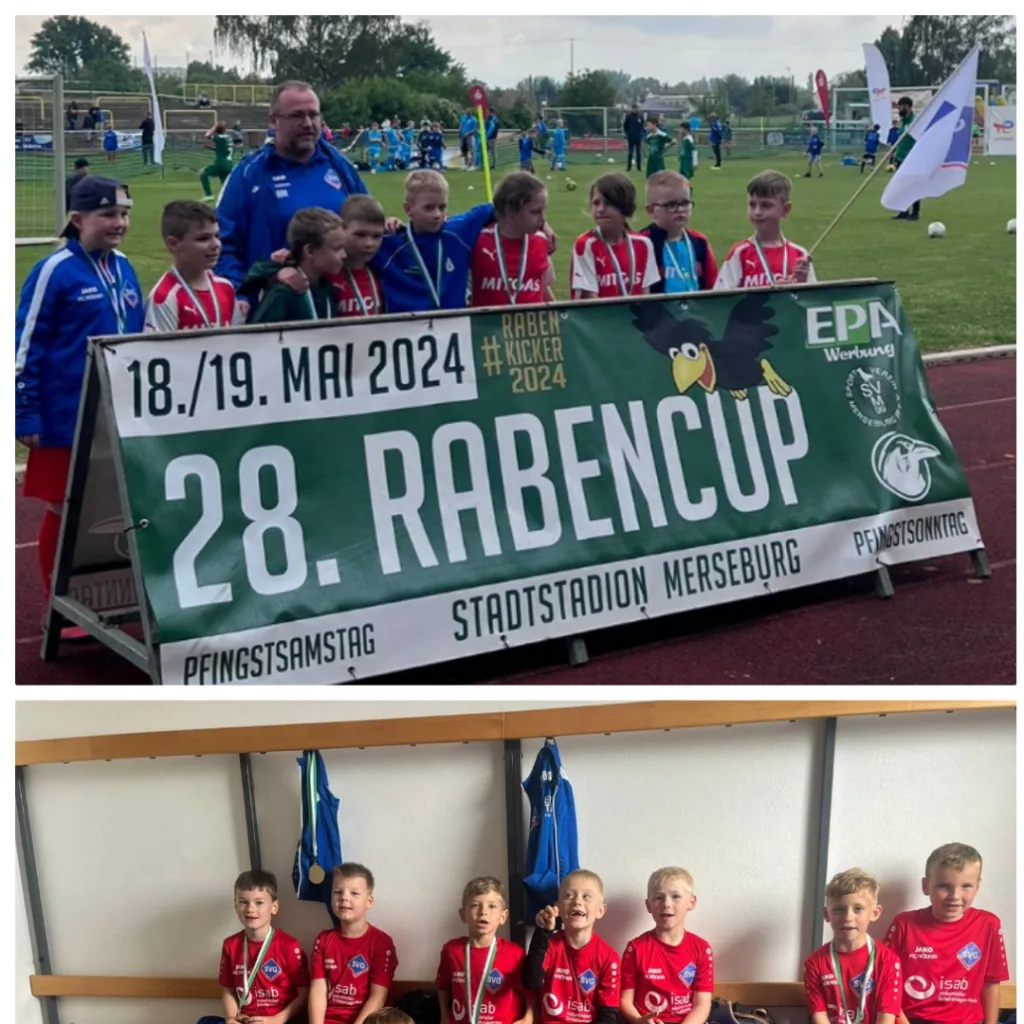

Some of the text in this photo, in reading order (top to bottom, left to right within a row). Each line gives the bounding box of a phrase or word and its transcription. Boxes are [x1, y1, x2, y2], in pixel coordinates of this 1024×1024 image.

[501, 311, 560, 339] RABEN
[806, 301, 902, 345] EPA
[504, 337, 564, 366] KICKER
[824, 344, 895, 362] Werbung
[127, 332, 465, 418] 18./19. MAI 2024
[509, 363, 567, 394] 2024
[163, 385, 811, 609] 28. RABENCUP
[183, 510, 968, 684] PFINGSTSAMSTAG STADTSTADION MERSEBURG PFINGSTSONNTAG
[264, 965, 278, 974] SVG
[352, 960, 366, 971] SVG
[333, 983, 357, 995] sab
[579, 977, 596, 986] SVG
[940, 976, 969, 990] isab
[254, 986, 279, 998] isab
[567, 997, 591, 1012] isab
